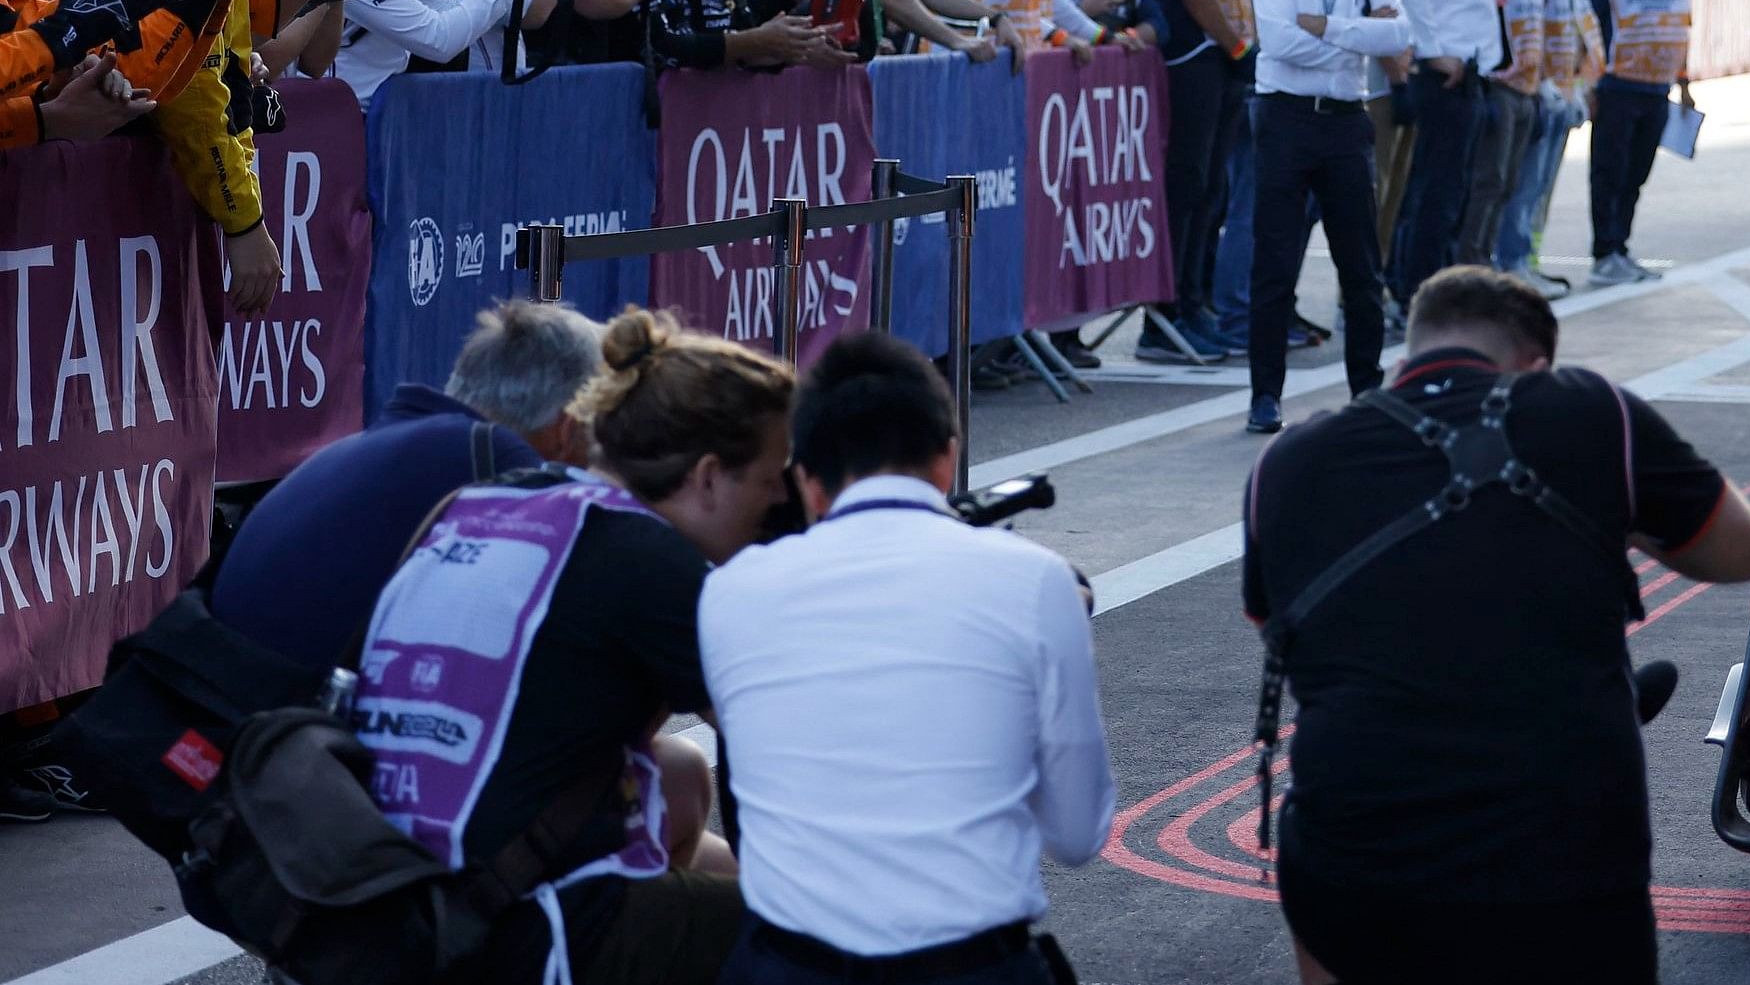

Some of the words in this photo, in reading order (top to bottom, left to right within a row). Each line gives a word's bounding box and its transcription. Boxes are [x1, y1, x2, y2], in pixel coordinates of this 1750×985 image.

[687, 122, 857, 280] QATAR
[1039, 84, 1153, 216] QATAR
[724, 258, 858, 342] AIRAYS
